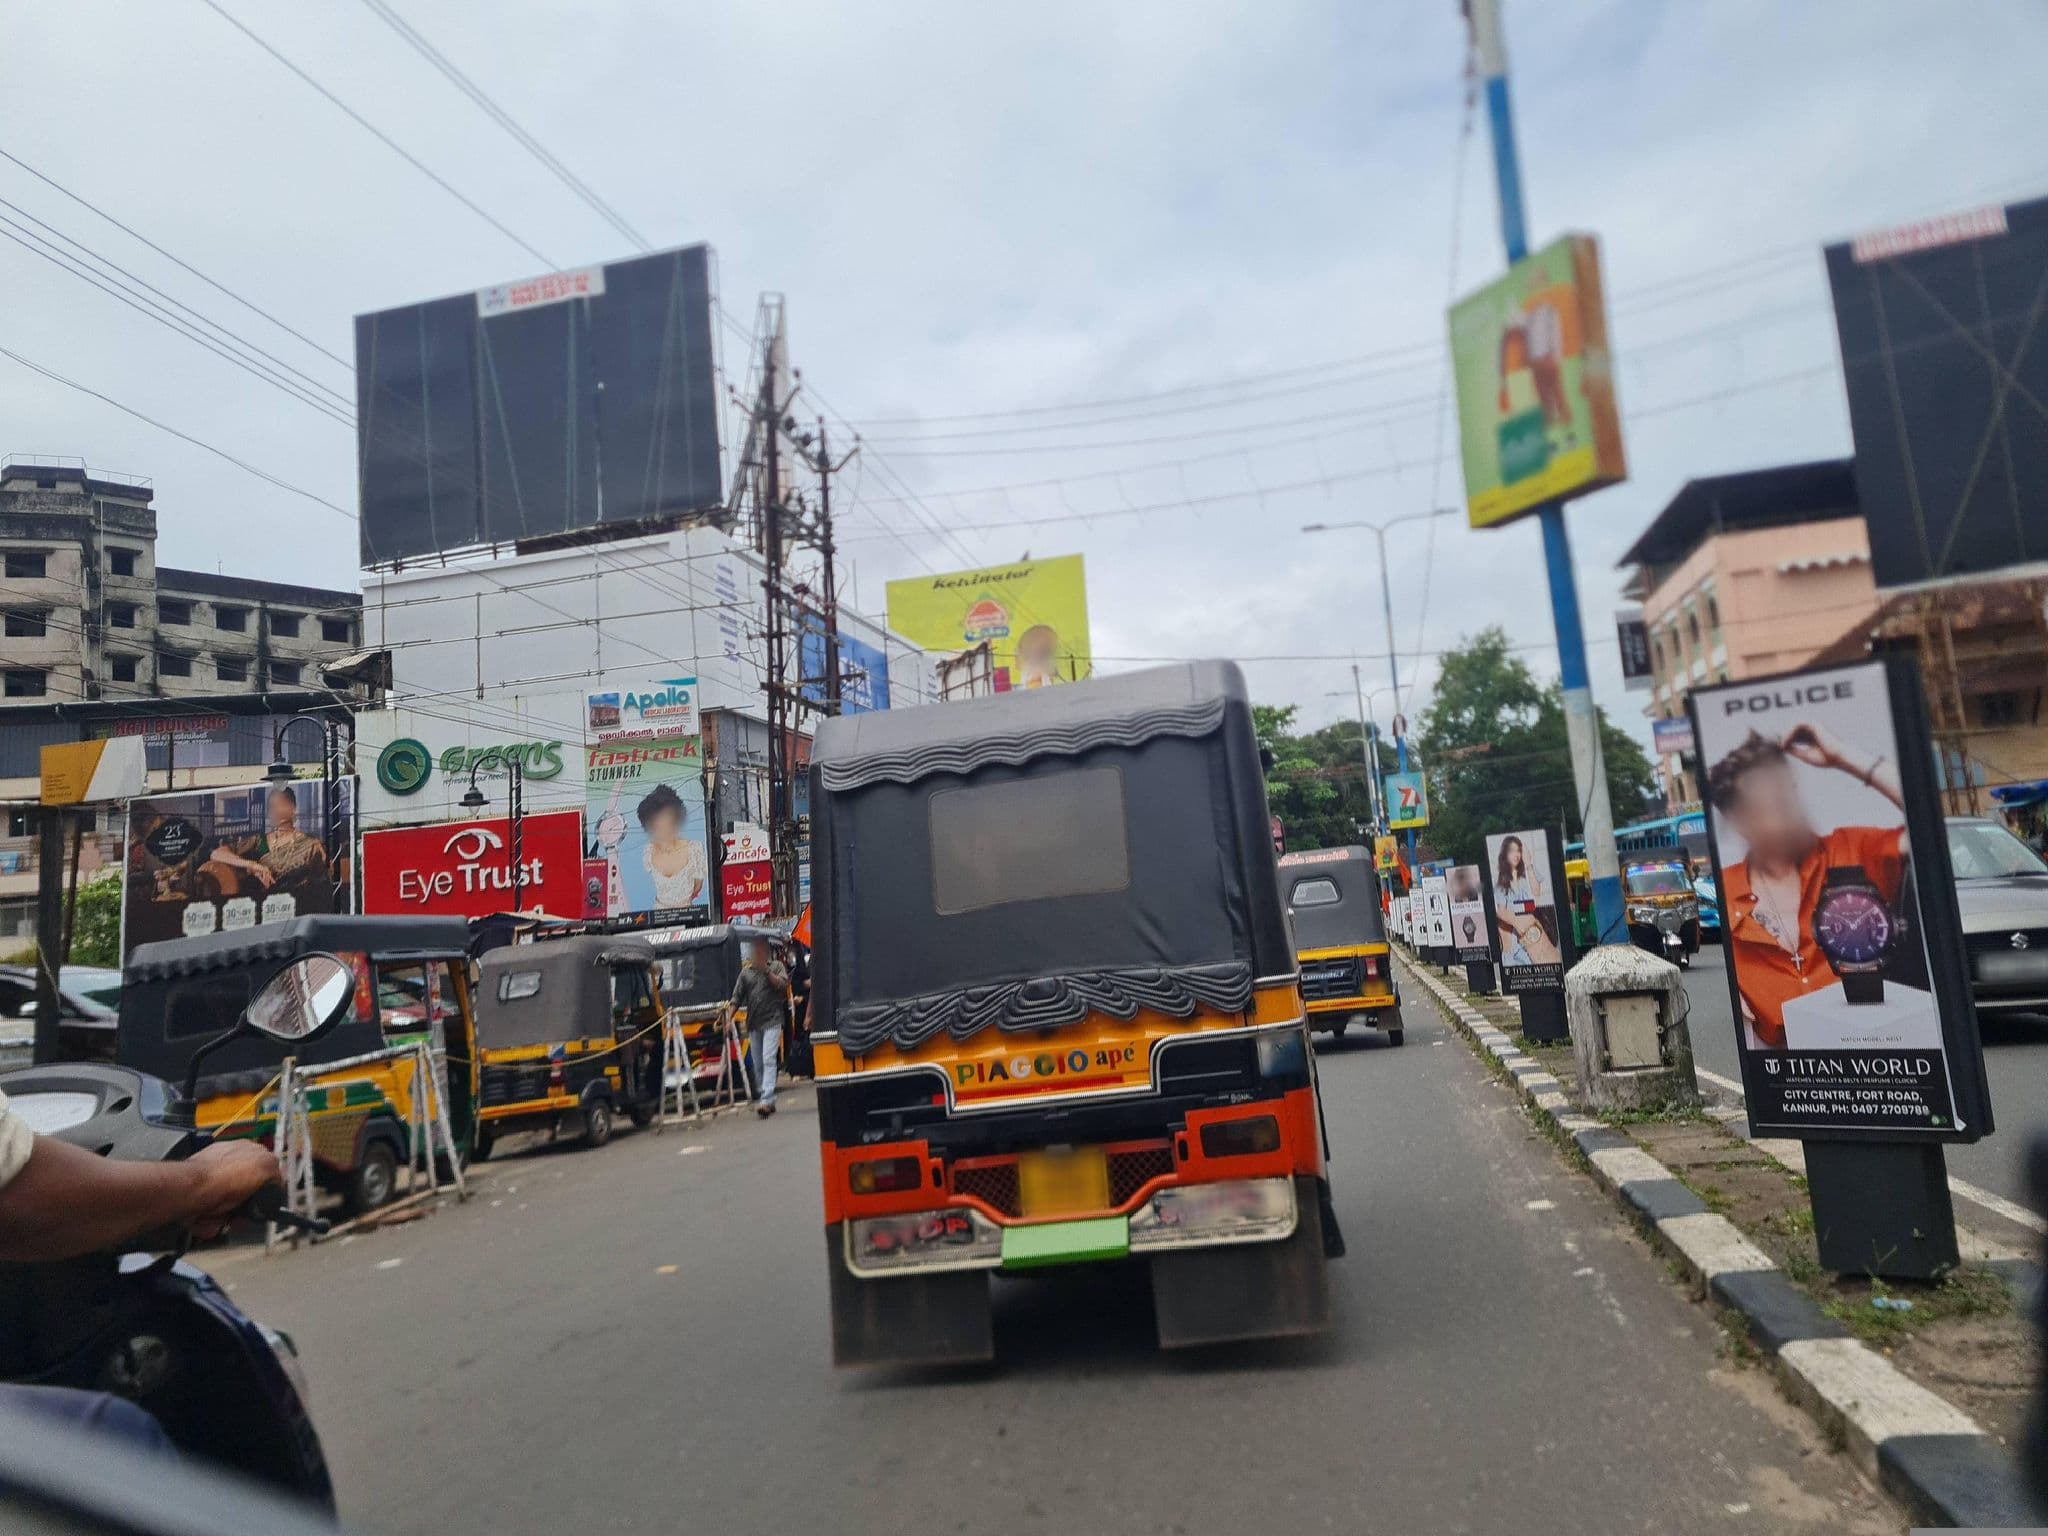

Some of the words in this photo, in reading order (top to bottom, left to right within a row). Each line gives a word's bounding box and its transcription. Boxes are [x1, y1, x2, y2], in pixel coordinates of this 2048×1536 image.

[623, 687, 690, 718] Apollo
[1724, 681, 1856, 717] POLICE
[439, 740, 564, 780] Greens
[588, 740, 697, 768] fastrack
[588, 764, 642, 783] STUNNERZ
[399, 869, 454, 904] Eye
[456, 858, 544, 893] Trust
[726, 883, 744, 897] Eye
[746, 880, 772, 894] Trust
[956, 1050, 1090, 1086] PIAGGIO
[1095, 1041, 1135, 1070] apé
[1786, 1058, 1843, 1075] TITAN
[1849, 1058, 1931, 1076] WORLD
[1782, 1103, 1830, 1114] KANNUR,
[1831, 1103, 1850, 1114] PH:
[1784, 1090, 1808, 1099] CITY
[1810, 1090, 1854, 1102] CENTRE,
[1856, 1090, 1884, 1100] FORT
[1887, 1091, 1923, 1103] ROAD,
[870, 1216, 969, 1250] OP
